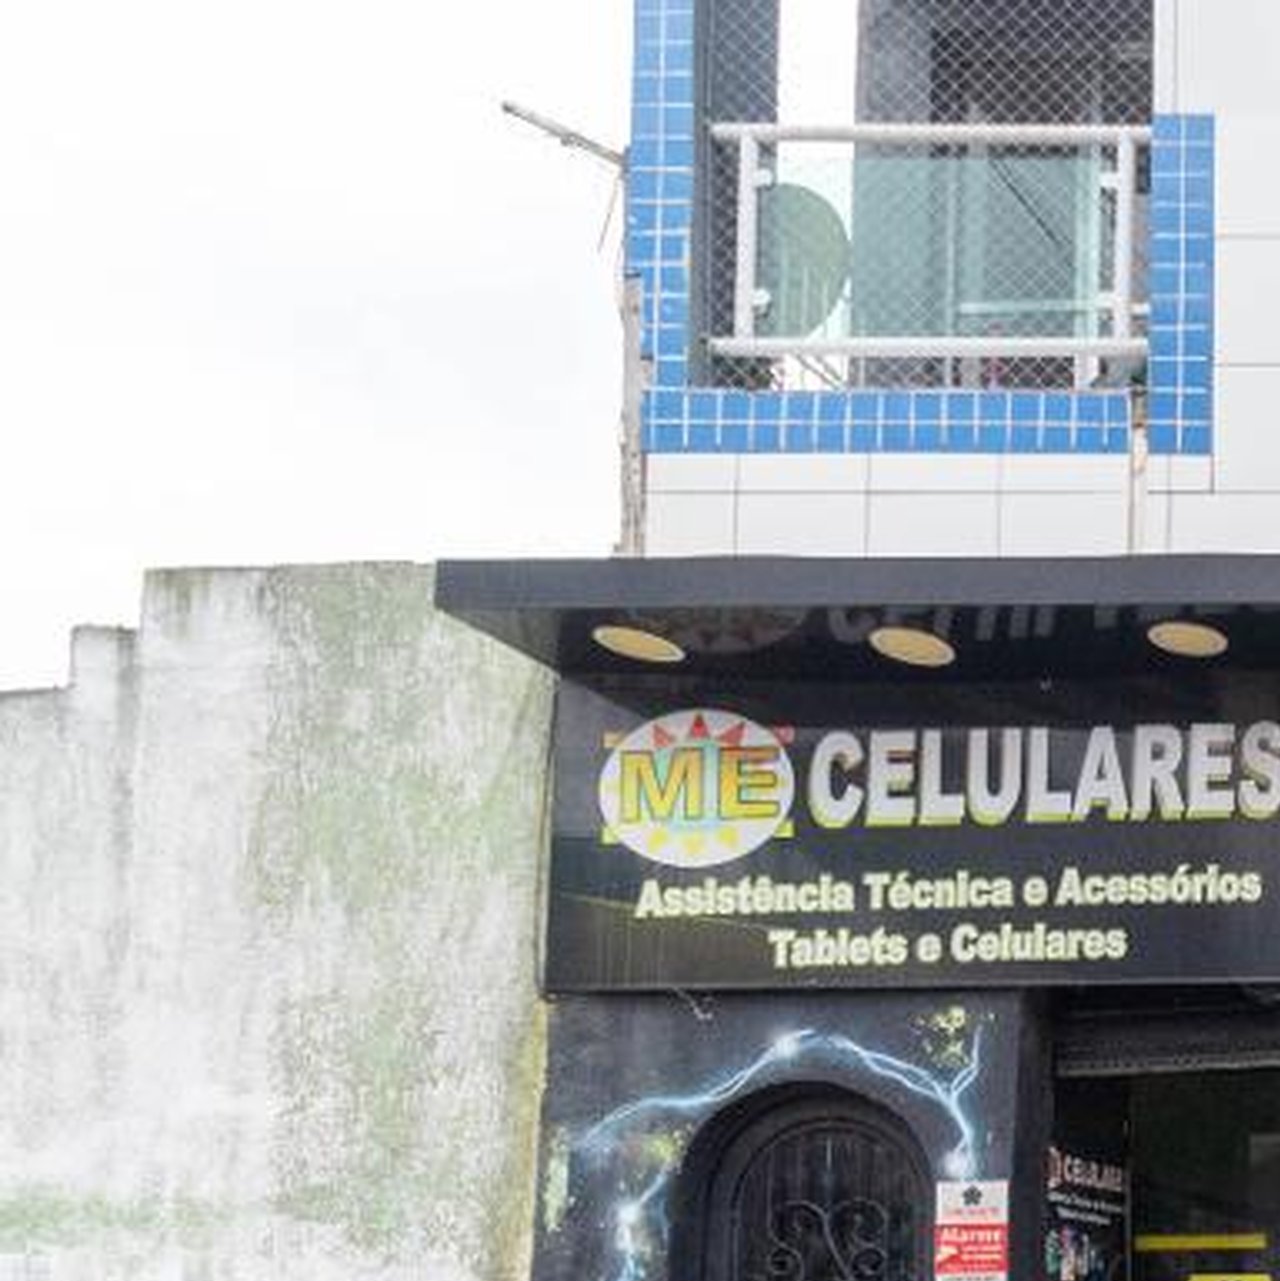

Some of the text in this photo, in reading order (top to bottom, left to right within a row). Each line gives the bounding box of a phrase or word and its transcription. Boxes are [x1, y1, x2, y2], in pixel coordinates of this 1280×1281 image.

[634, 864, 1263, 918] Assistência Técnica e Acessórios
[768, 922, 1129, 968] Tablets e Celulares
